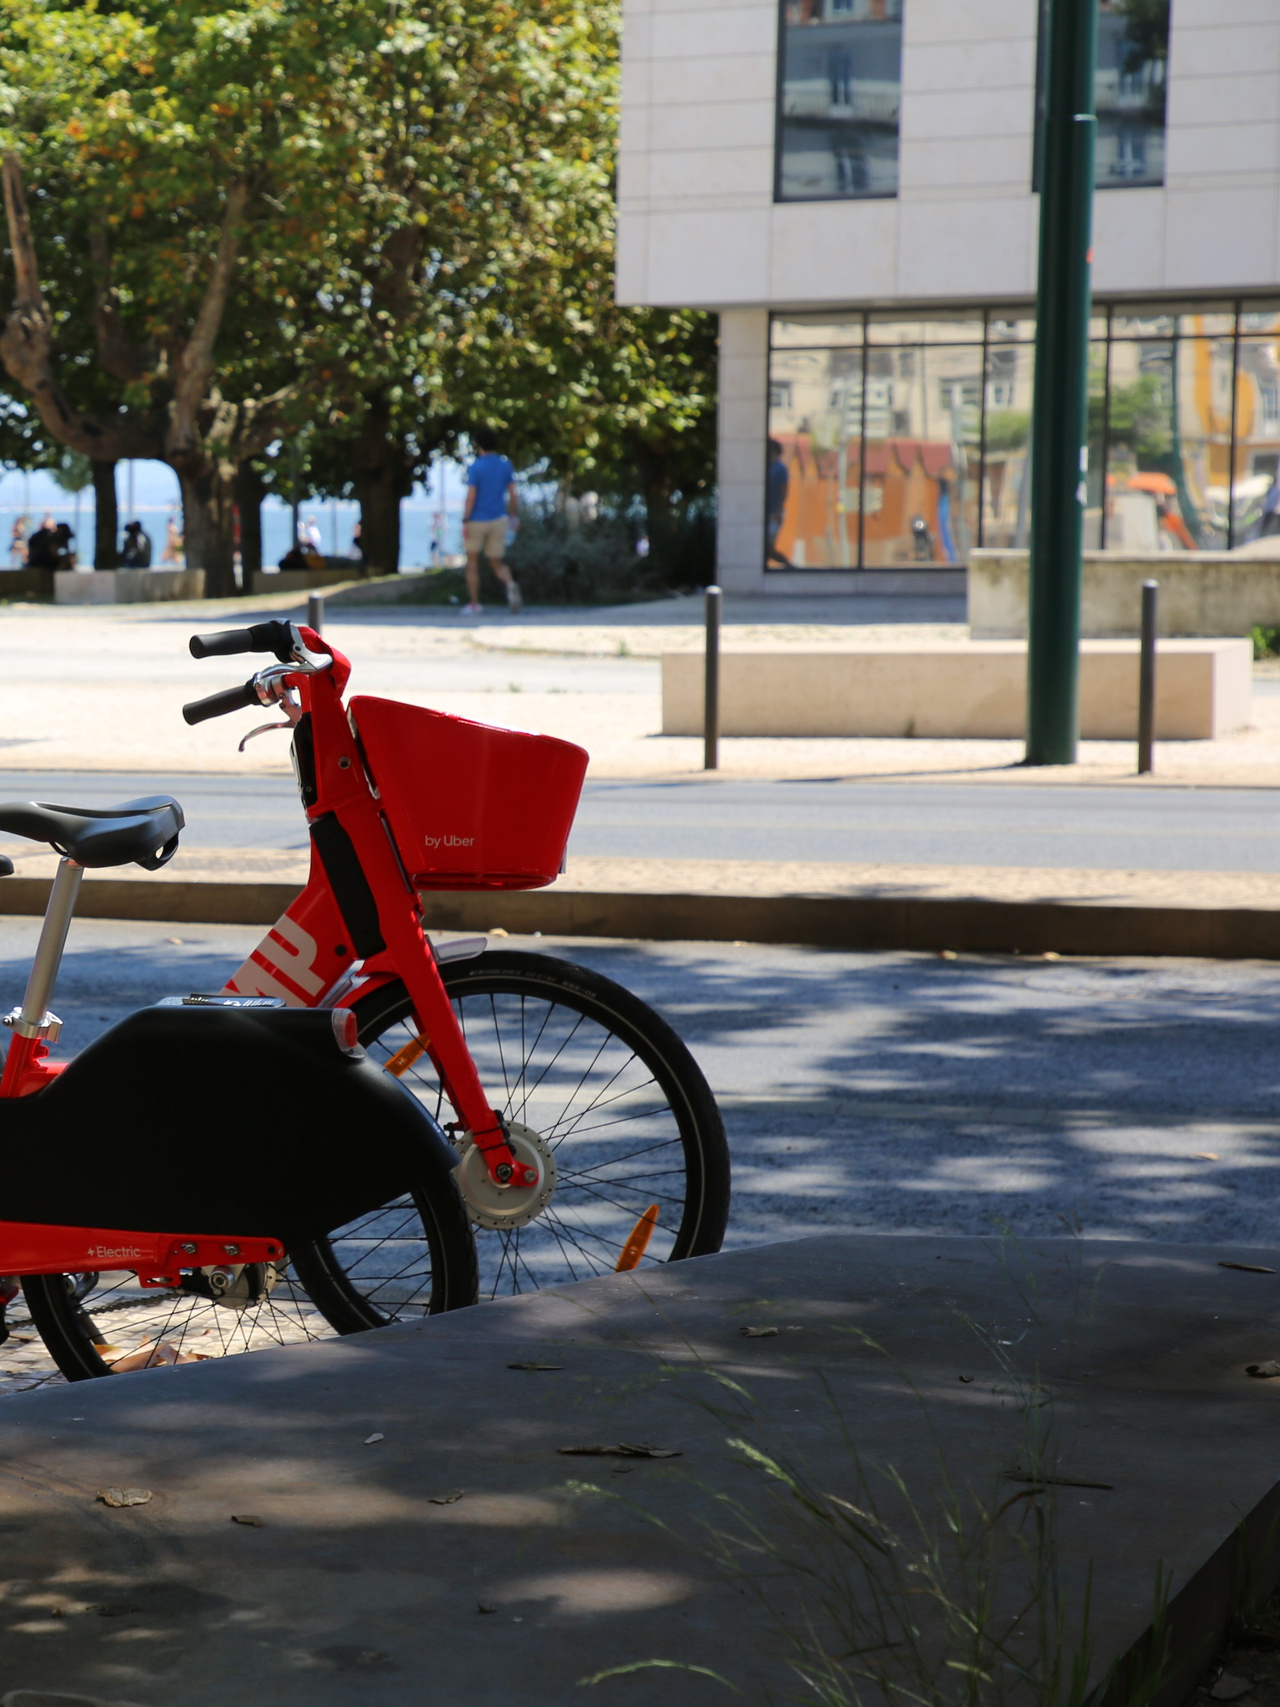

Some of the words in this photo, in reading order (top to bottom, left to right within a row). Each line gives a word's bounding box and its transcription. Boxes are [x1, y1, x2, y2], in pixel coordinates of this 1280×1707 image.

[425, 835, 441, 849] by
[443, 835, 475, 847] Uber
[219, 914, 326, 1007] MP
[96, 1246, 141, 1258] Electric
